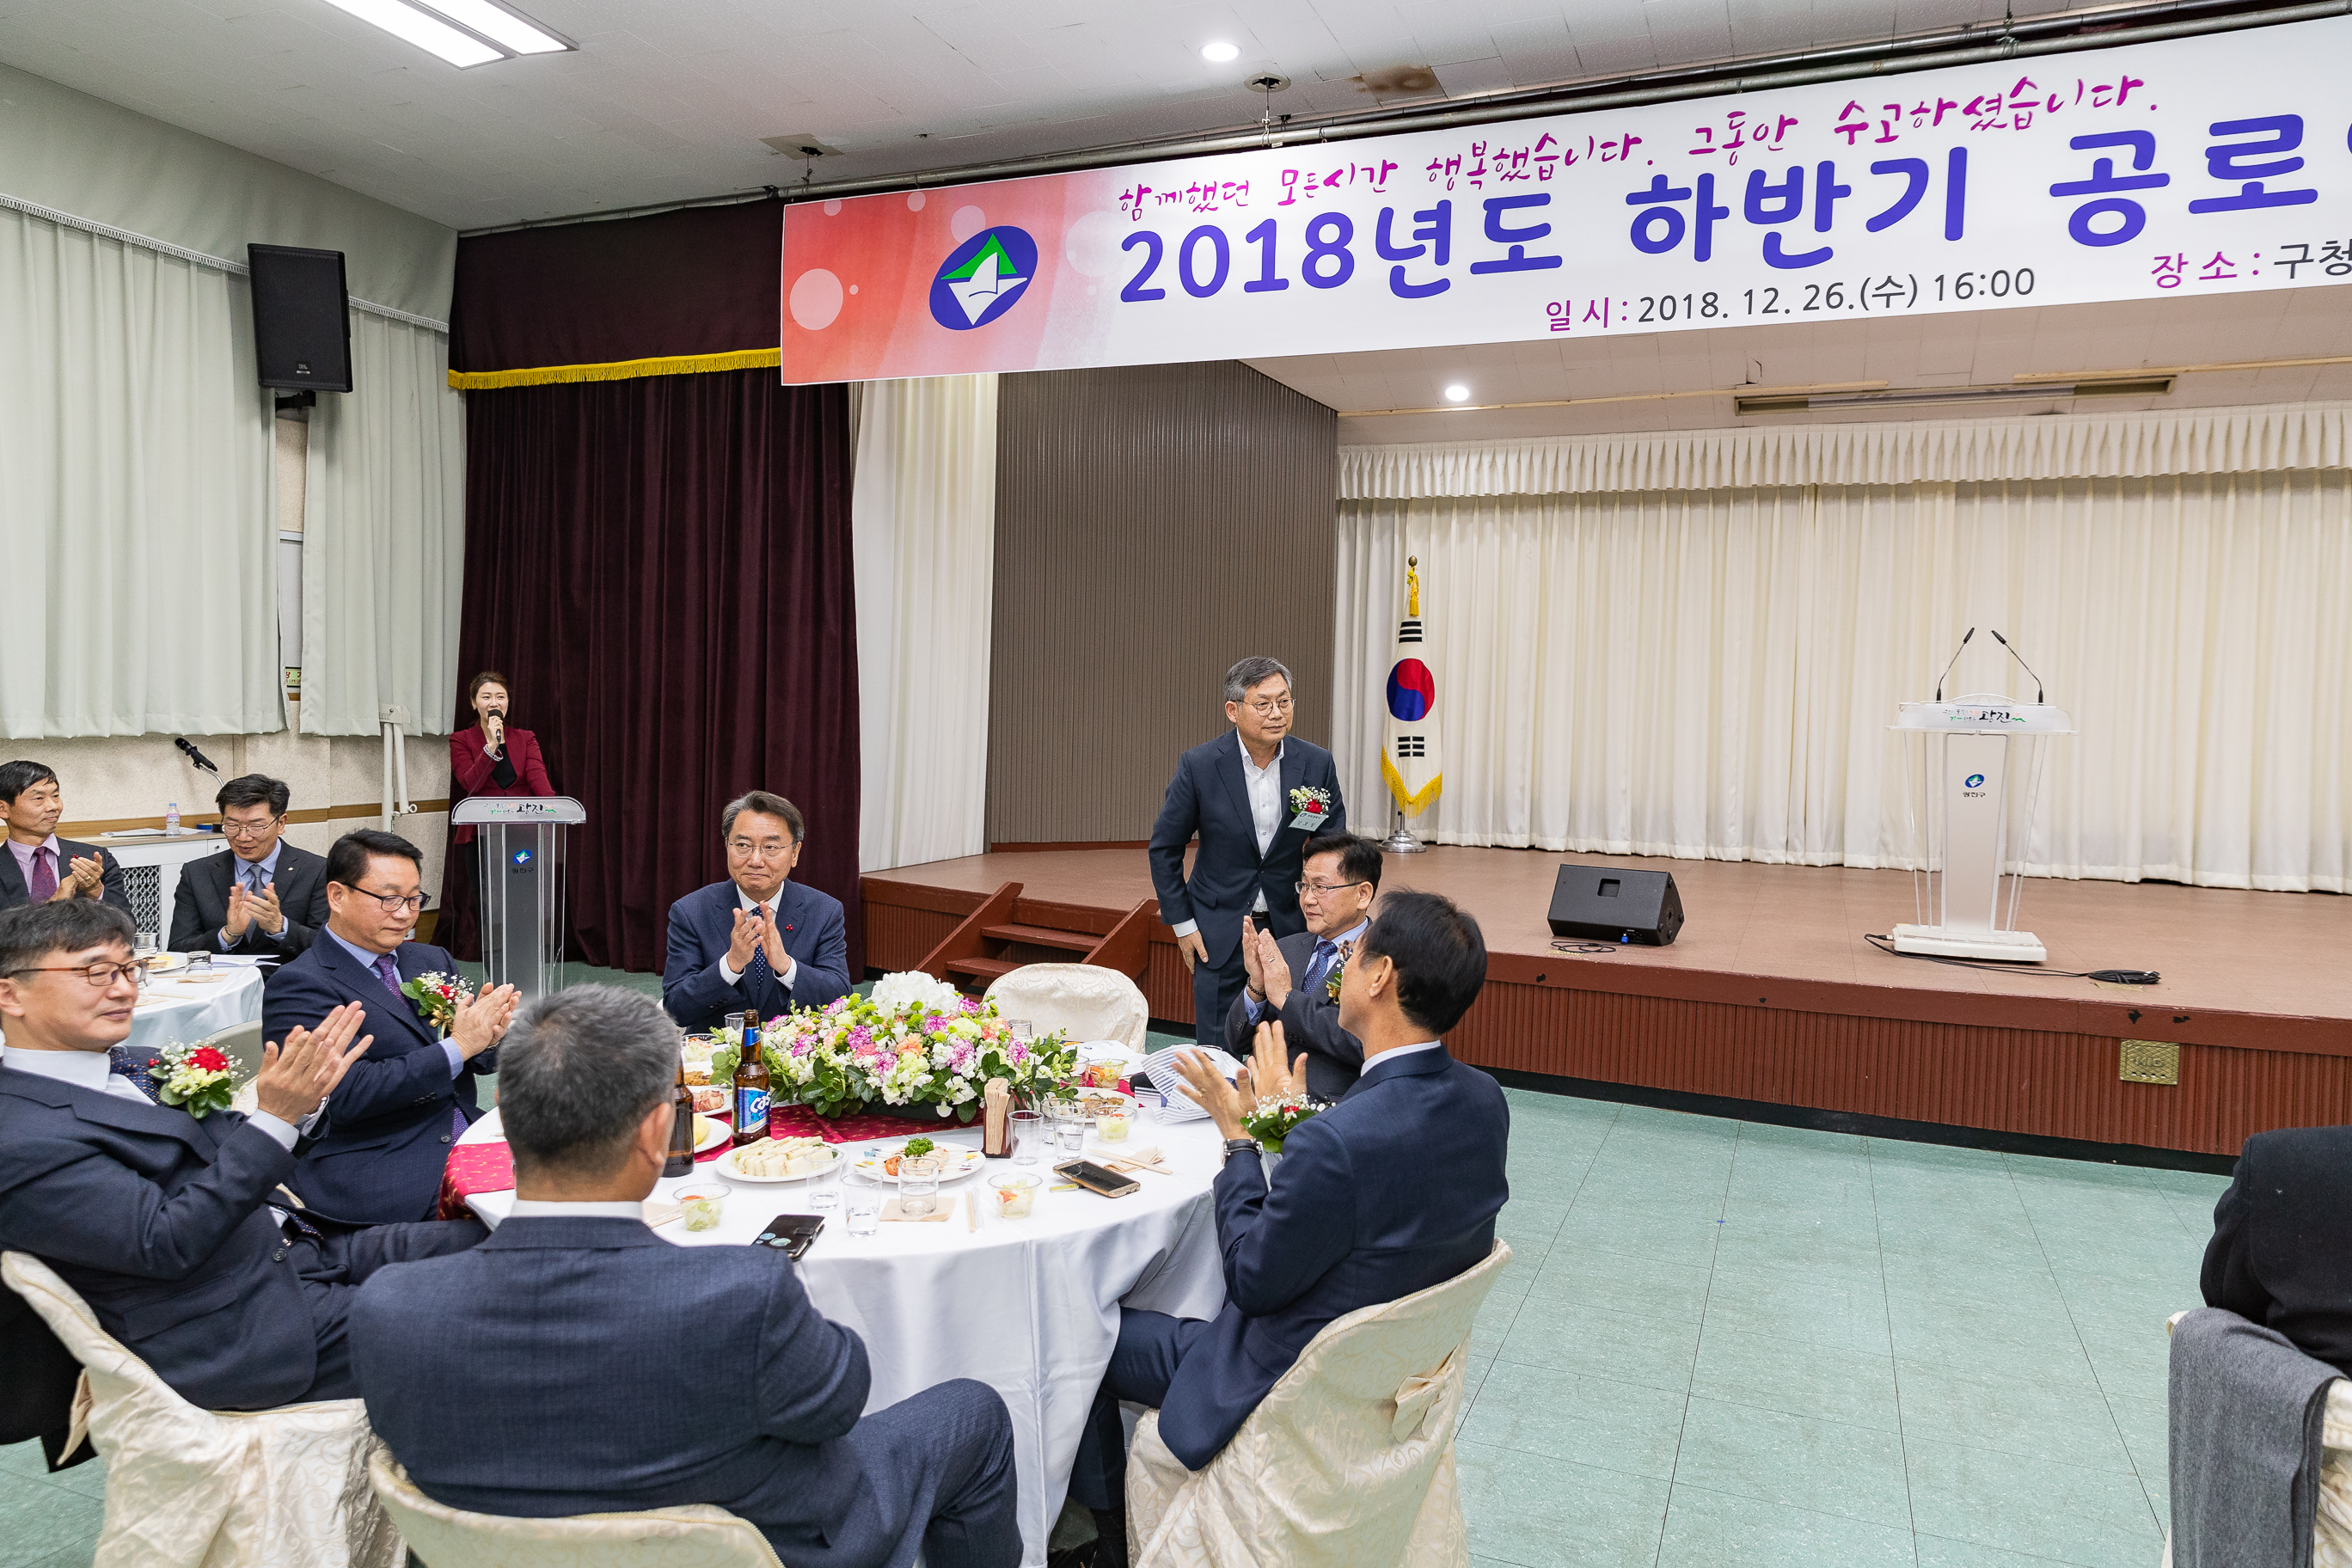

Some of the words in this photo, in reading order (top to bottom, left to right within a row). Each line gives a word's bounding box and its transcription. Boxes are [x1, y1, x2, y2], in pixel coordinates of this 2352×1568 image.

[1118, 180, 1250, 222] 함께했던
[1277, 158, 1399, 207] 모든시간
[1426, 132, 1654, 192] 행복했습니다.
[1688, 110, 1799, 167] 그동안
[1834, 75, 2159, 146] 수고하셨습니다.
[1119, 192, 1564, 303] 2018년도
[1625, 145, 1969, 270] 하반기
[2048, 113, 2352, 248] 공로
[1743, 287, 1791, 315] 12.
[1803, 273, 1919, 312] 26.(수)
[1933, 267, 2036, 303] 16:00
[1979, 709, 2012, 724] 광진
[516, 802, 545, 815] 광진
